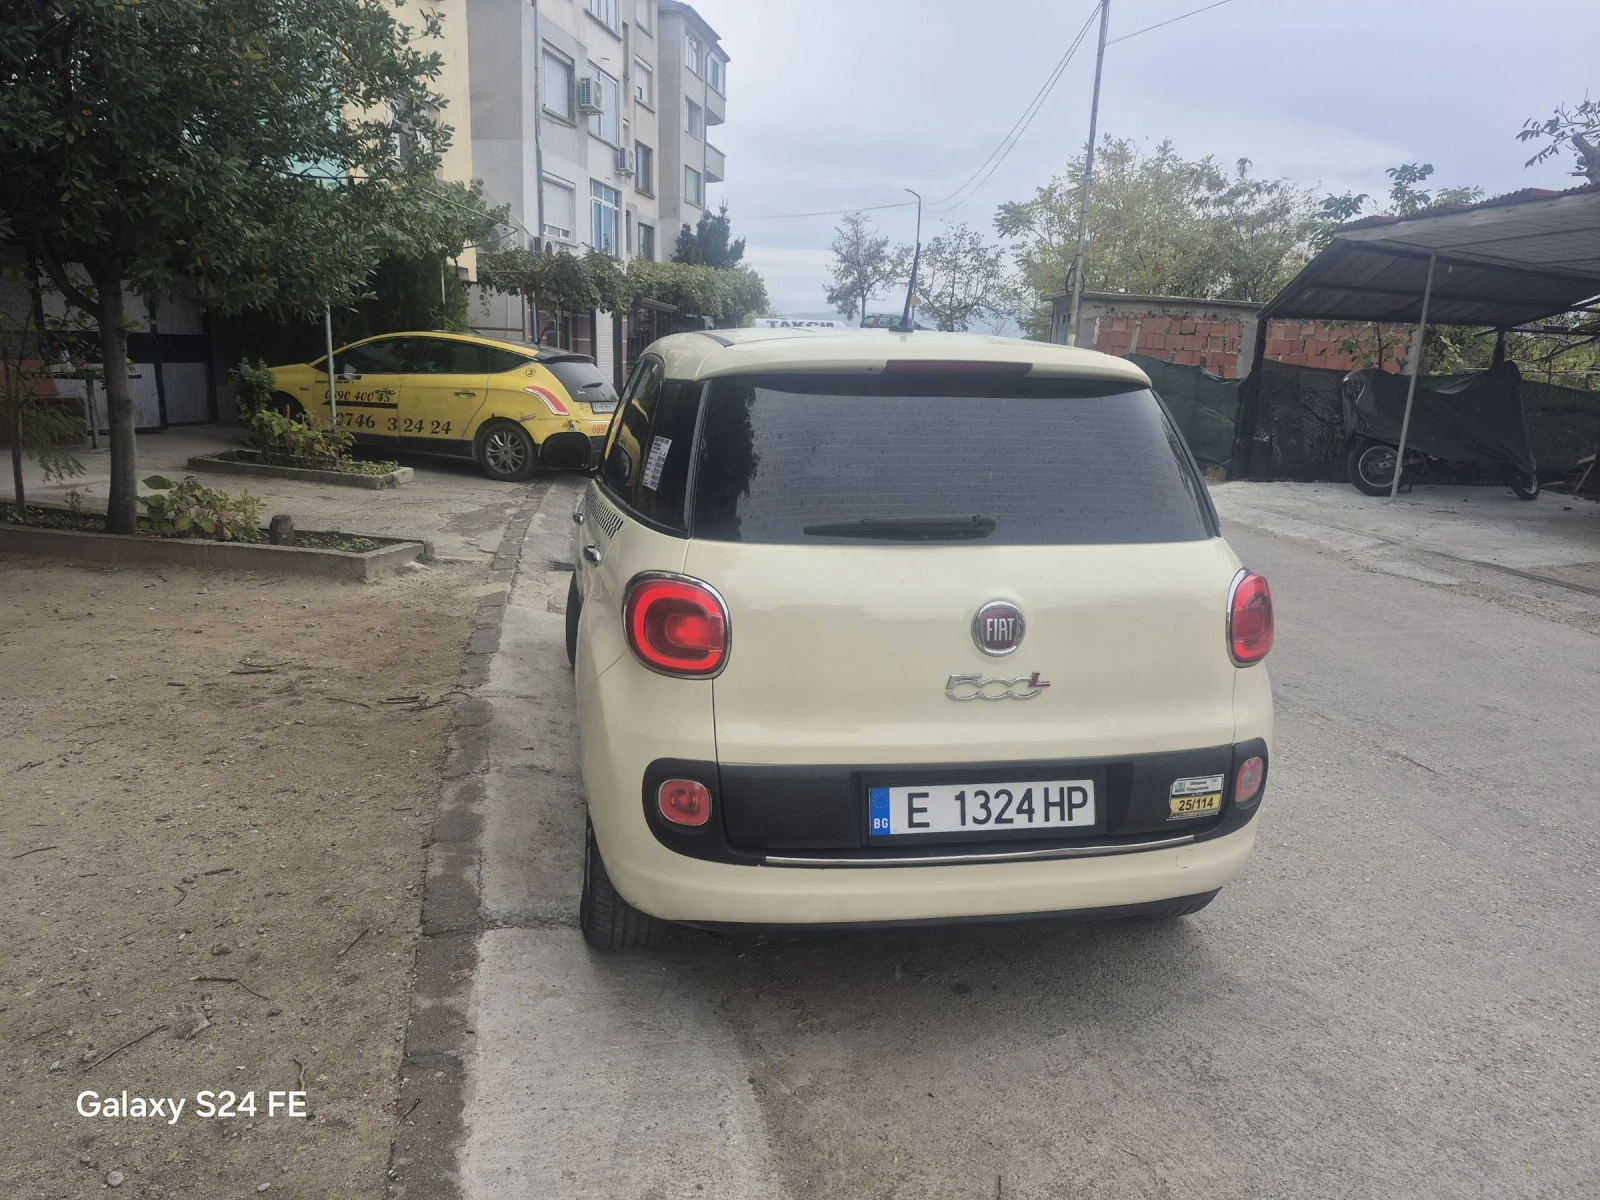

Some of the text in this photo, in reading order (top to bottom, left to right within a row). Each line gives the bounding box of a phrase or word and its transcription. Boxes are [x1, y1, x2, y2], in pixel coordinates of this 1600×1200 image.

[325, 390, 390, 403] 090 400 45
[404, 418, 425, 433] 24
[431, 420, 452, 435] 24
[986, 618, 1015, 641] FIAT
[907, 792, 930, 828] E
[1178, 796, 1214, 811] 25/114
[873, 818, 889, 829] BG
